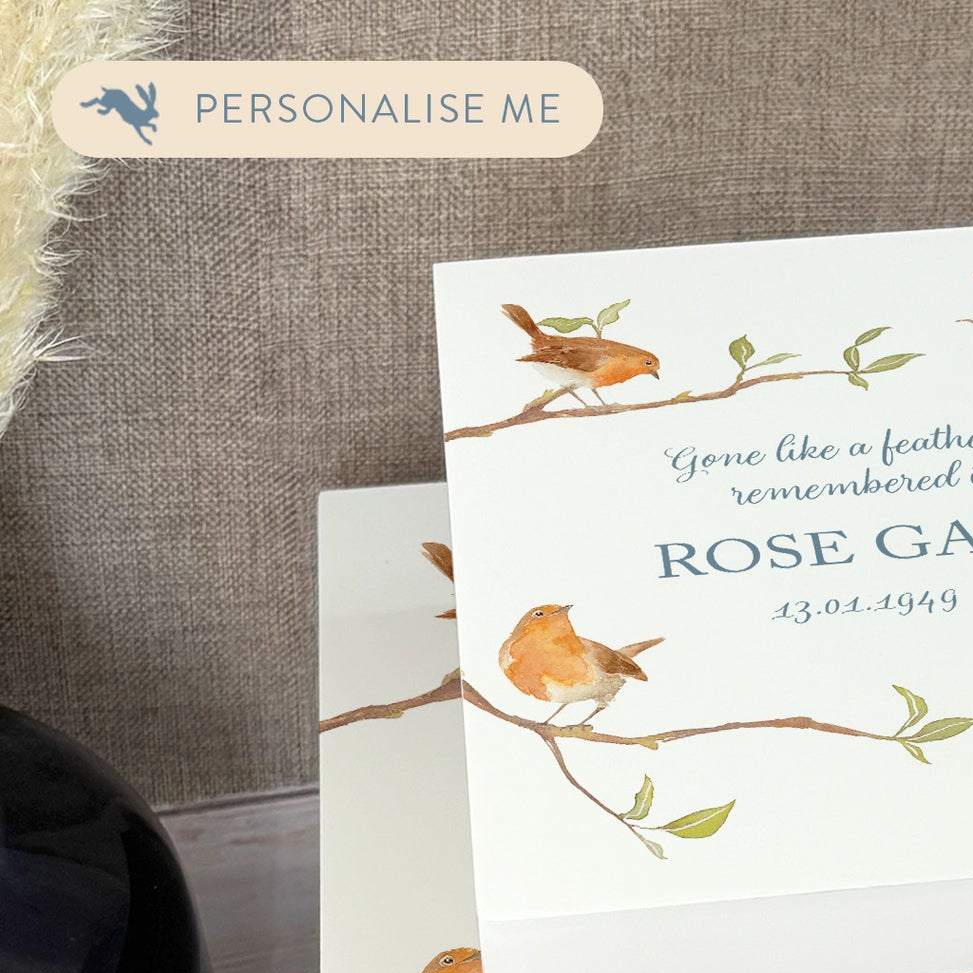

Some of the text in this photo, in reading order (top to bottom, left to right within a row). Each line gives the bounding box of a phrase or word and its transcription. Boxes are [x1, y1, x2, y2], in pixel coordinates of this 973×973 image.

[664, 446, 767, 484] Gone
[776, 434, 841, 463] like
[848, 442, 873, 458] a
[731, 459, 961, 506] remembered
[653, 529, 855, 579] ROSE
[772, 588, 958, 625] 13.01.1949
